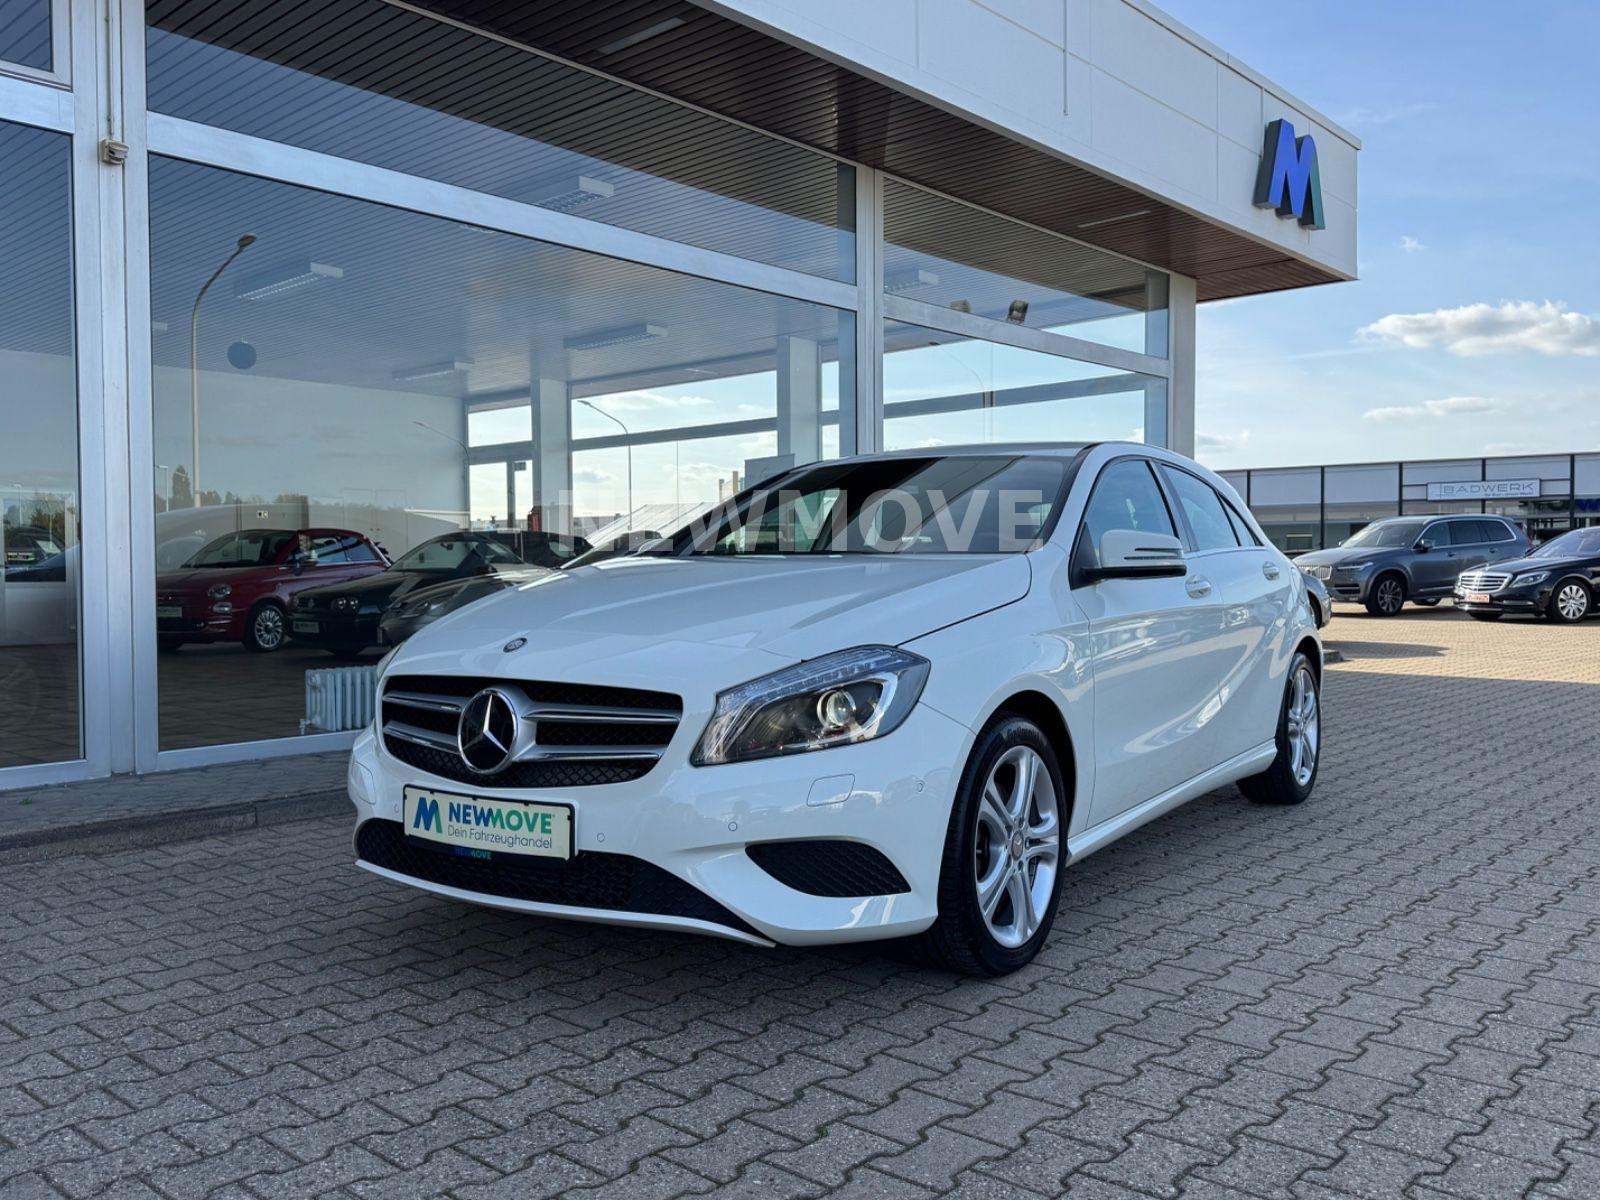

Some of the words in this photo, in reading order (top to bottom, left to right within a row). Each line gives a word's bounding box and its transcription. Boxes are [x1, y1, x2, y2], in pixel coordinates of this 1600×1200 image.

[1252, 118, 1325, 230] M
[1443, 482, 1534, 494] BADWERK
[448, 802, 552, 835] NEWMOVE
[448, 824, 468, 838] Dein
[470, 829, 552, 849] Fahrzeughandel
